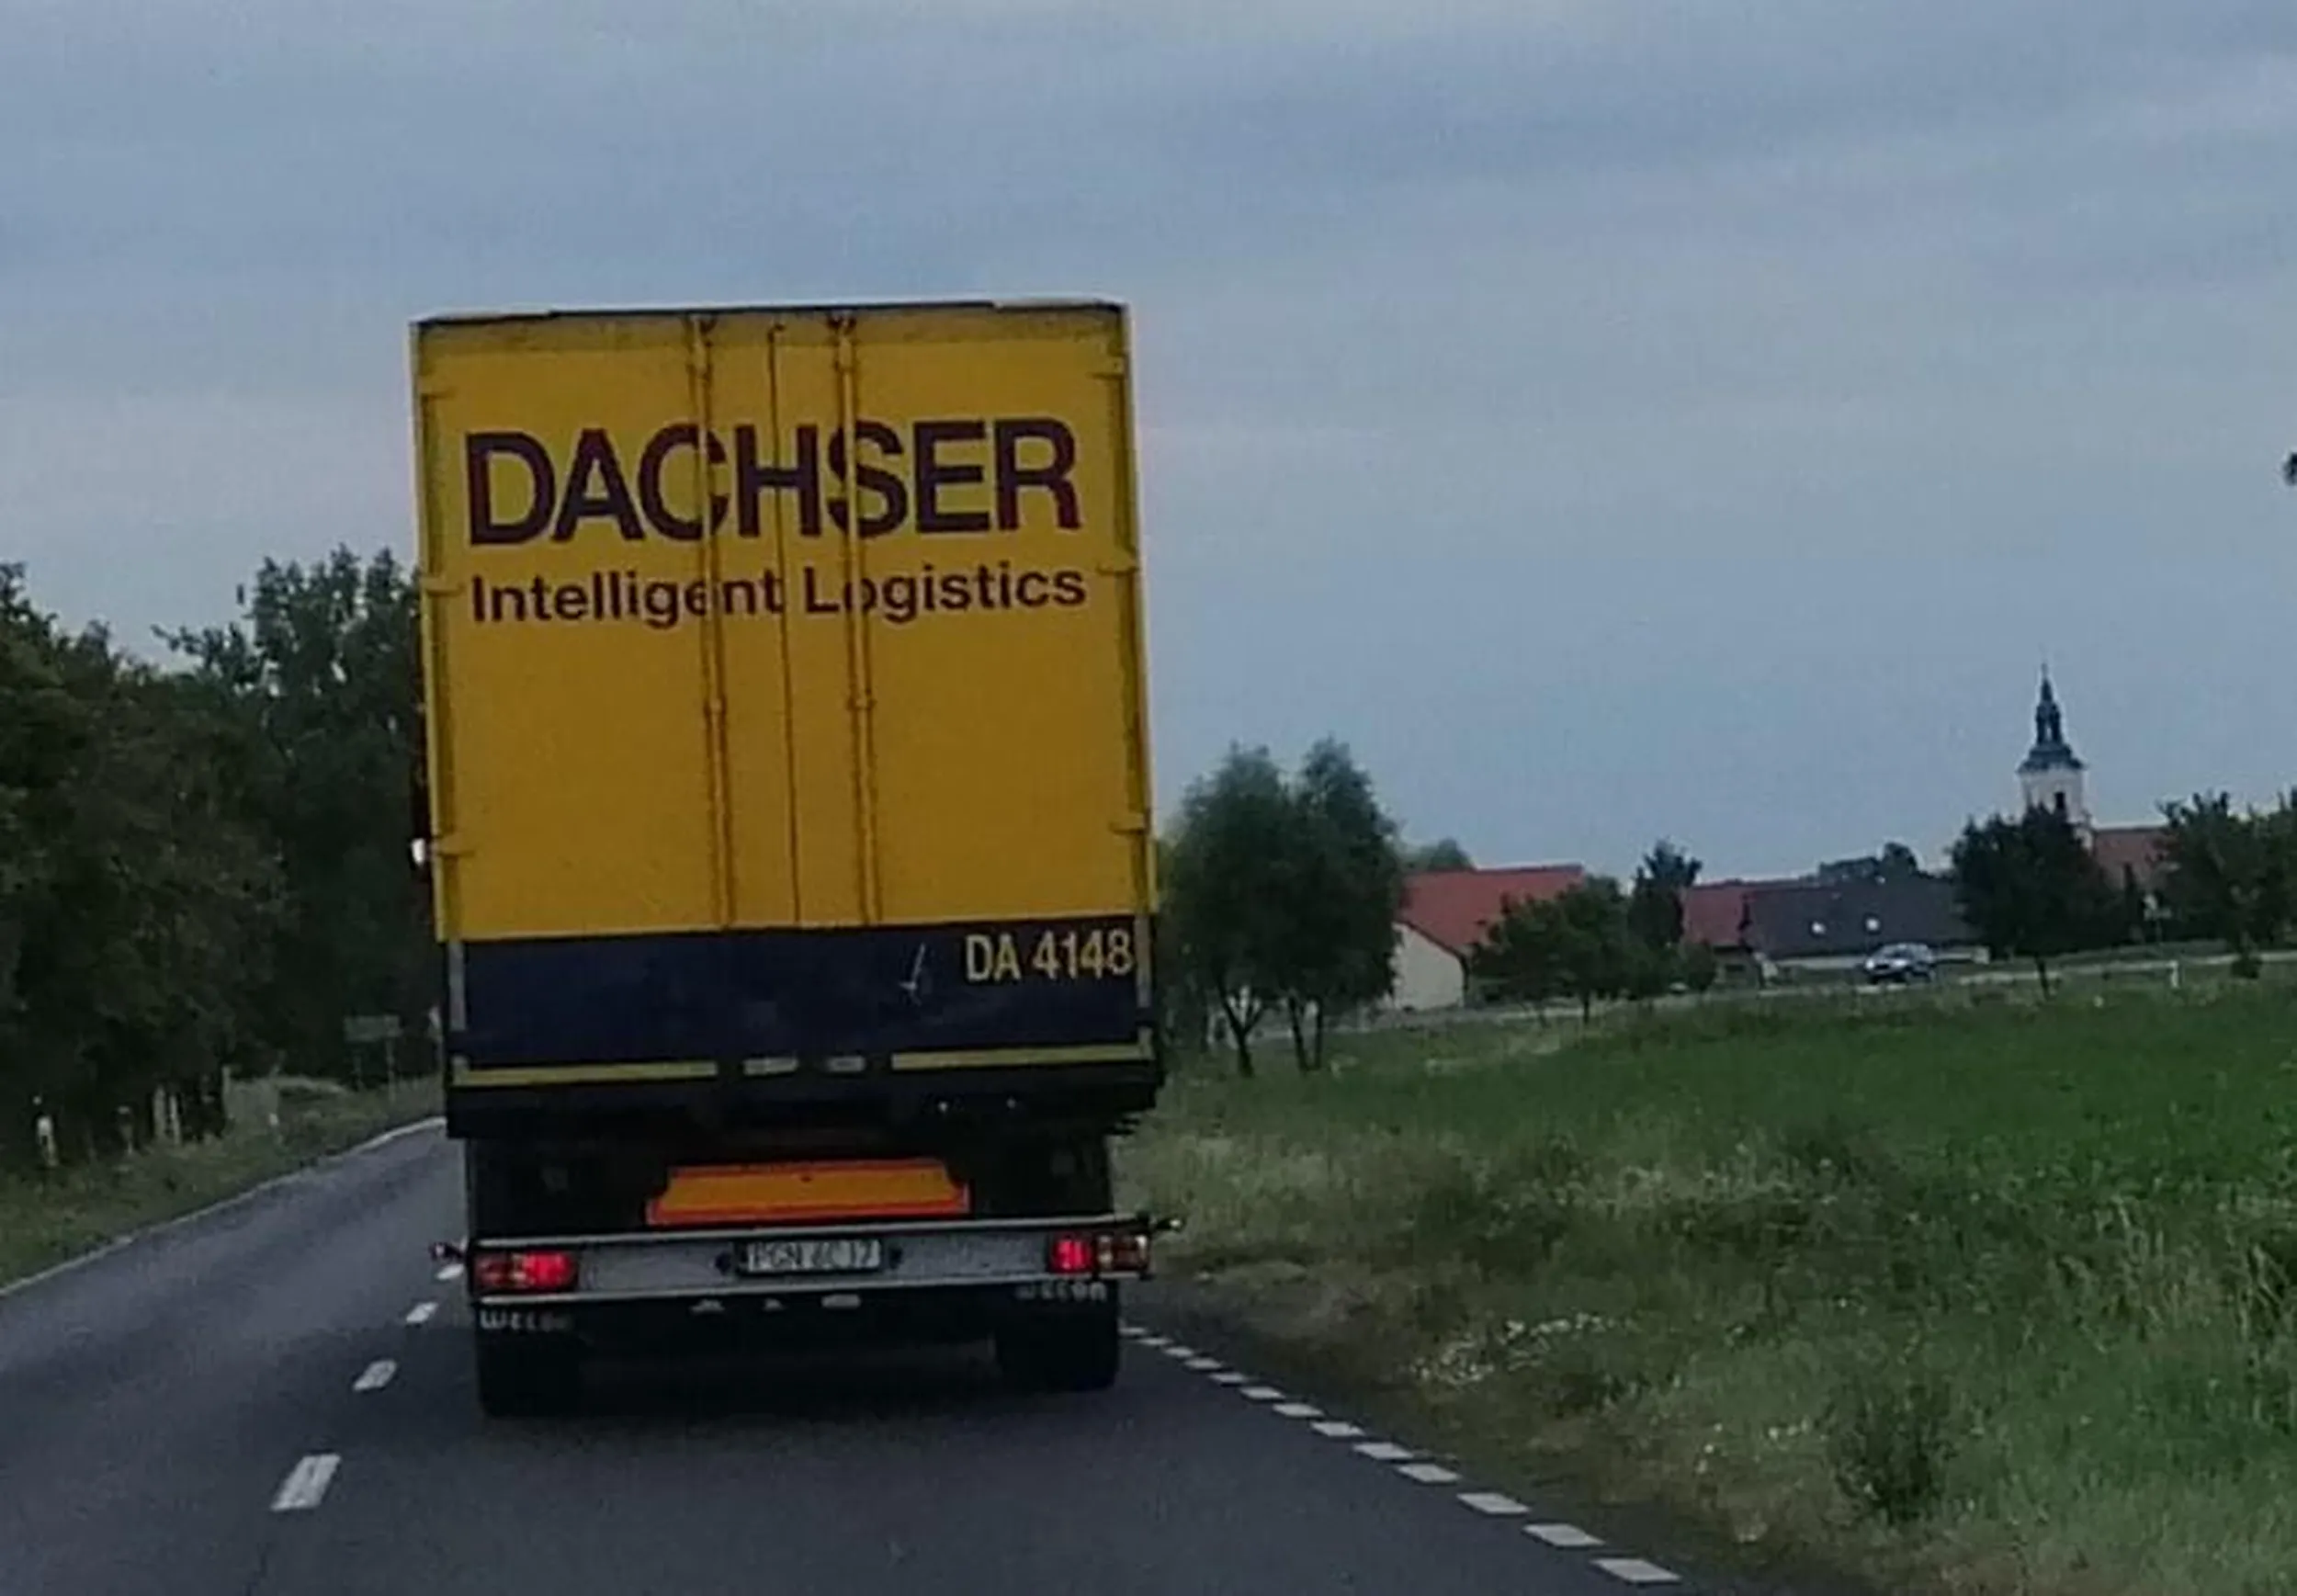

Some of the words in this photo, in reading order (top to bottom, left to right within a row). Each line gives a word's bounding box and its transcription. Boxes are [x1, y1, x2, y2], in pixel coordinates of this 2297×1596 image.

[464, 419, 1081, 545] DACHSER
[472, 568, 783, 628] Intelligent
[805, 563, 1086, 624] Logistics
[967, 934, 1021, 981] DA
[1033, 930, 1134, 979] 4148
